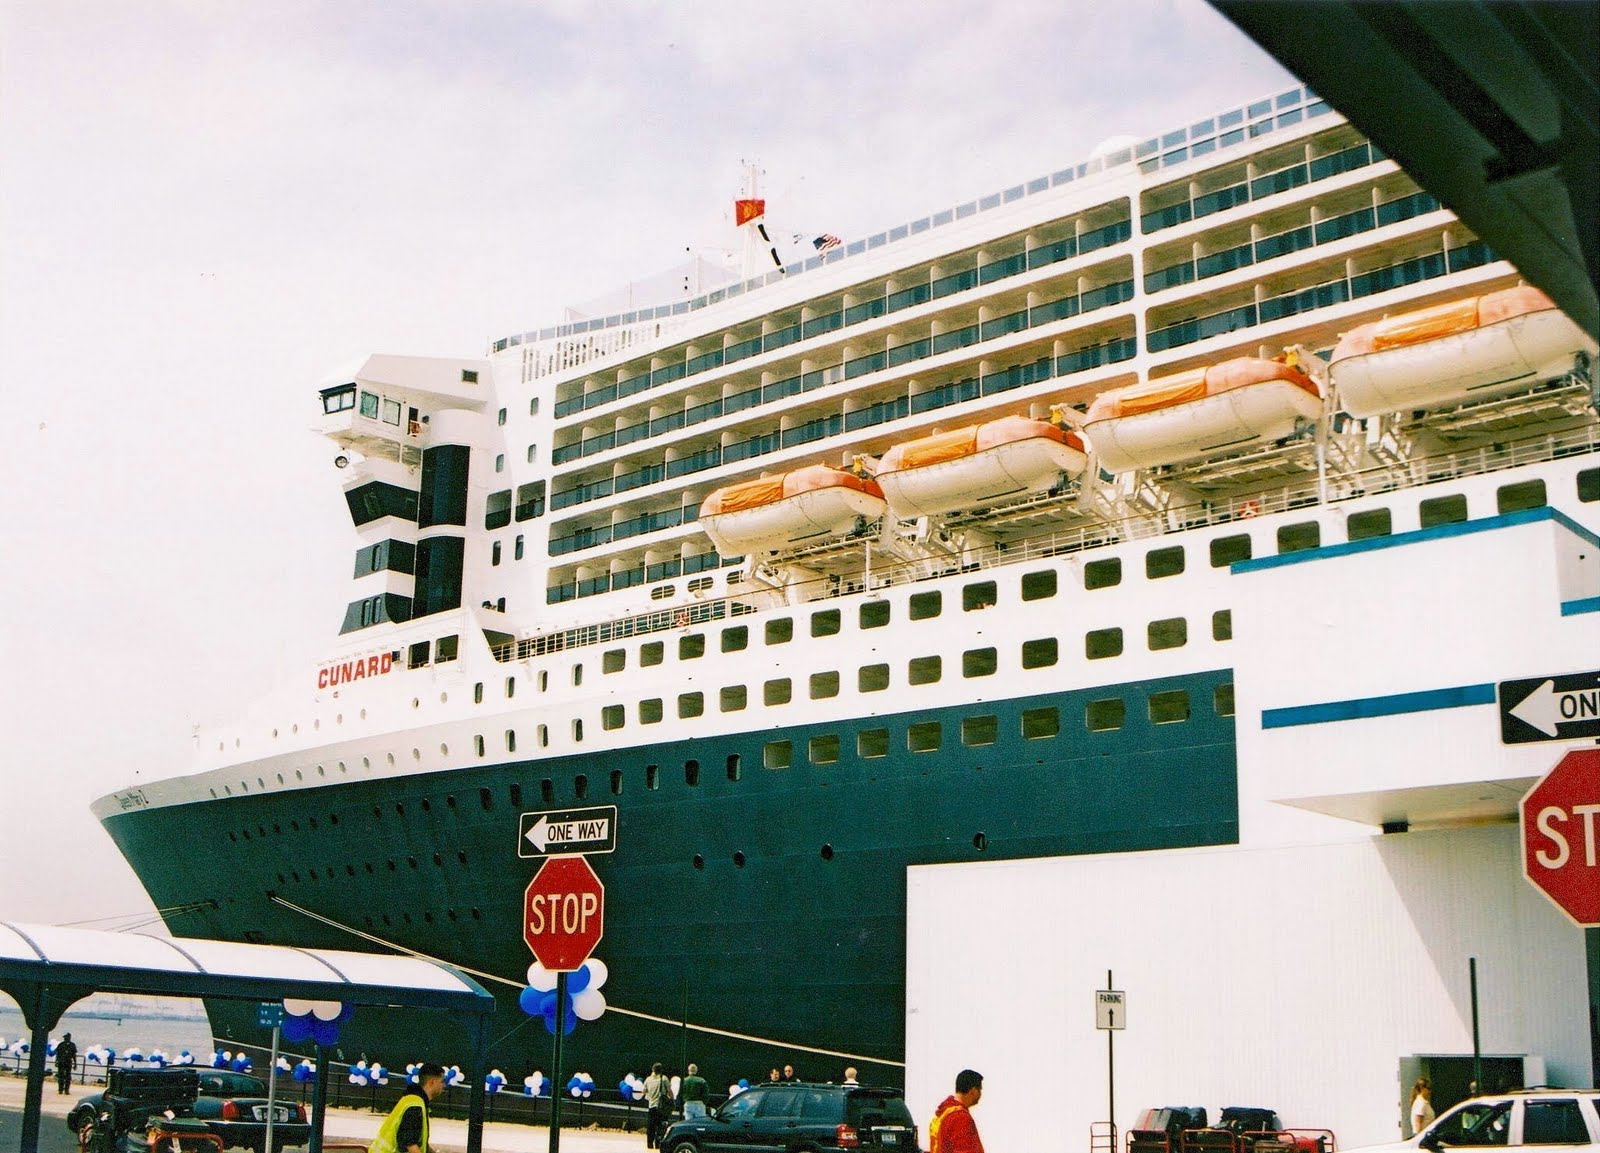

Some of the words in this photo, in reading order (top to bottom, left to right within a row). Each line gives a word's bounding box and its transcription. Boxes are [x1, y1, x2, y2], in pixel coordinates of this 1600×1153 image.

[317, 652, 392, 690] CUNARD
[1560, 691, 1600, 719] ON
[547, 824, 573, 842] ONE
[578, 821, 606, 840] WAY
[529, 892, 598, 936] STOP
